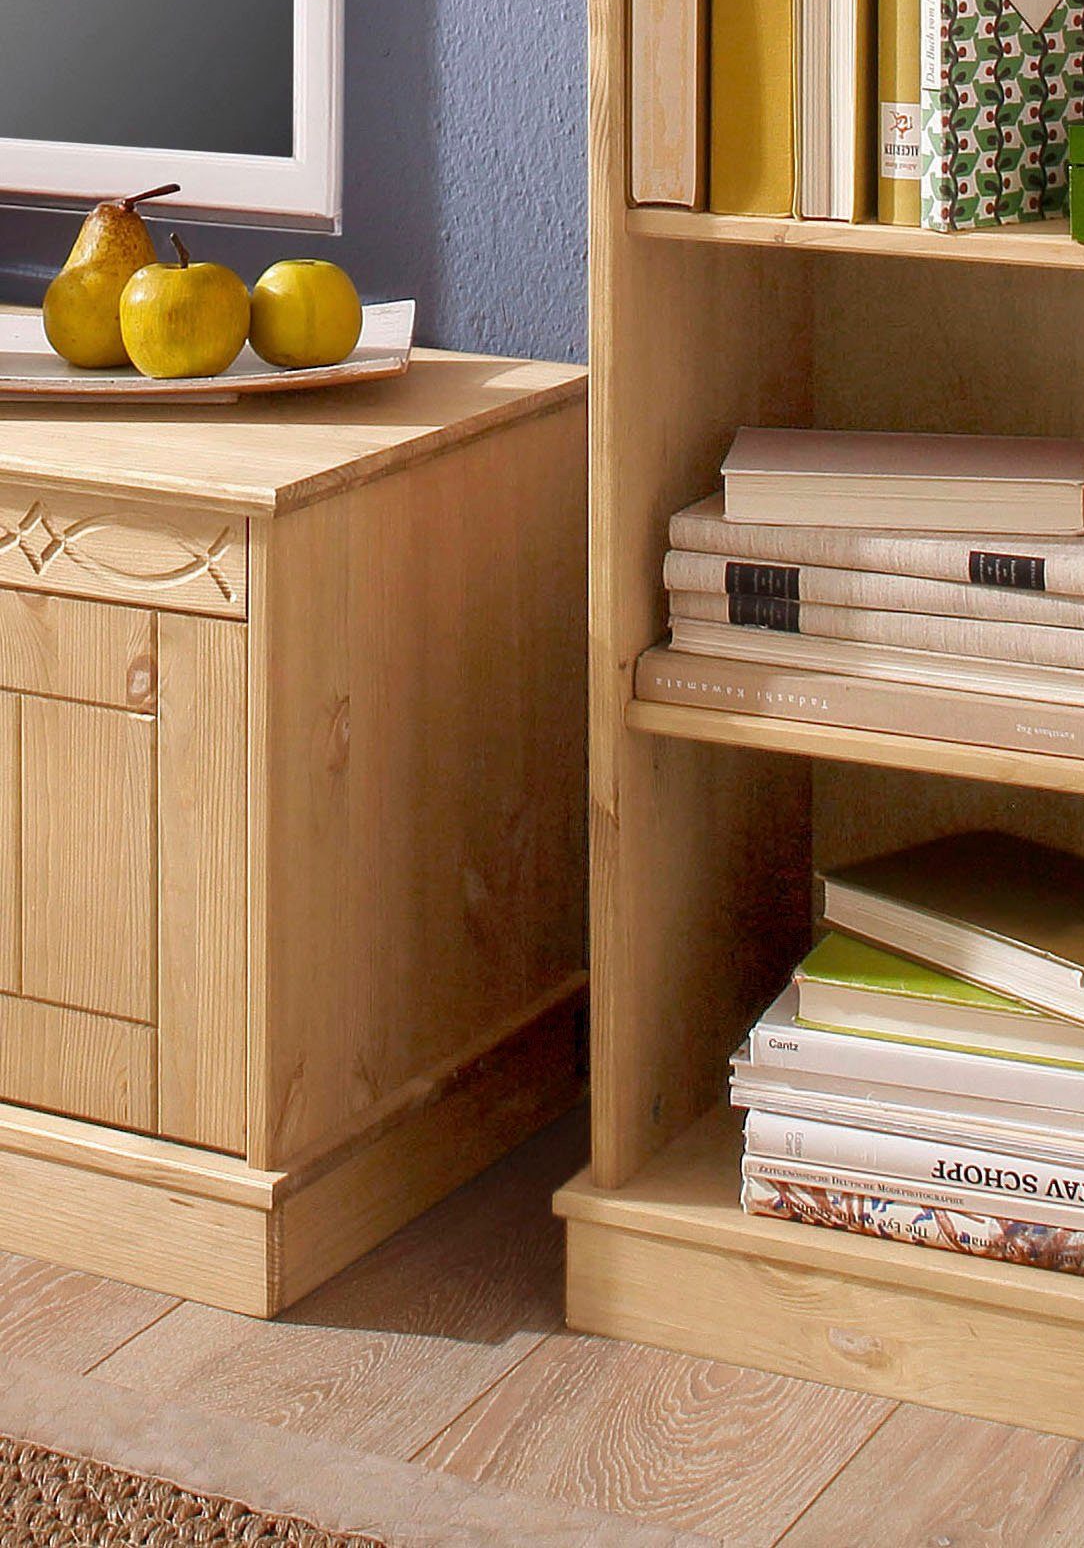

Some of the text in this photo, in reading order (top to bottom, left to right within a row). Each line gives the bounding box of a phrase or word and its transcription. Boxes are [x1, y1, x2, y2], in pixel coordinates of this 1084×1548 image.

[926, 63, 935, 84] Das
[655, 677, 829, 710] Tadashi Kawamata
[768, 1038, 799, 1051] Cantz
[930, 1159, 1038, 1194] SCHOPF
[880, 1217, 901, 1234] Eye
[905, 1224, 929, 1239] The
